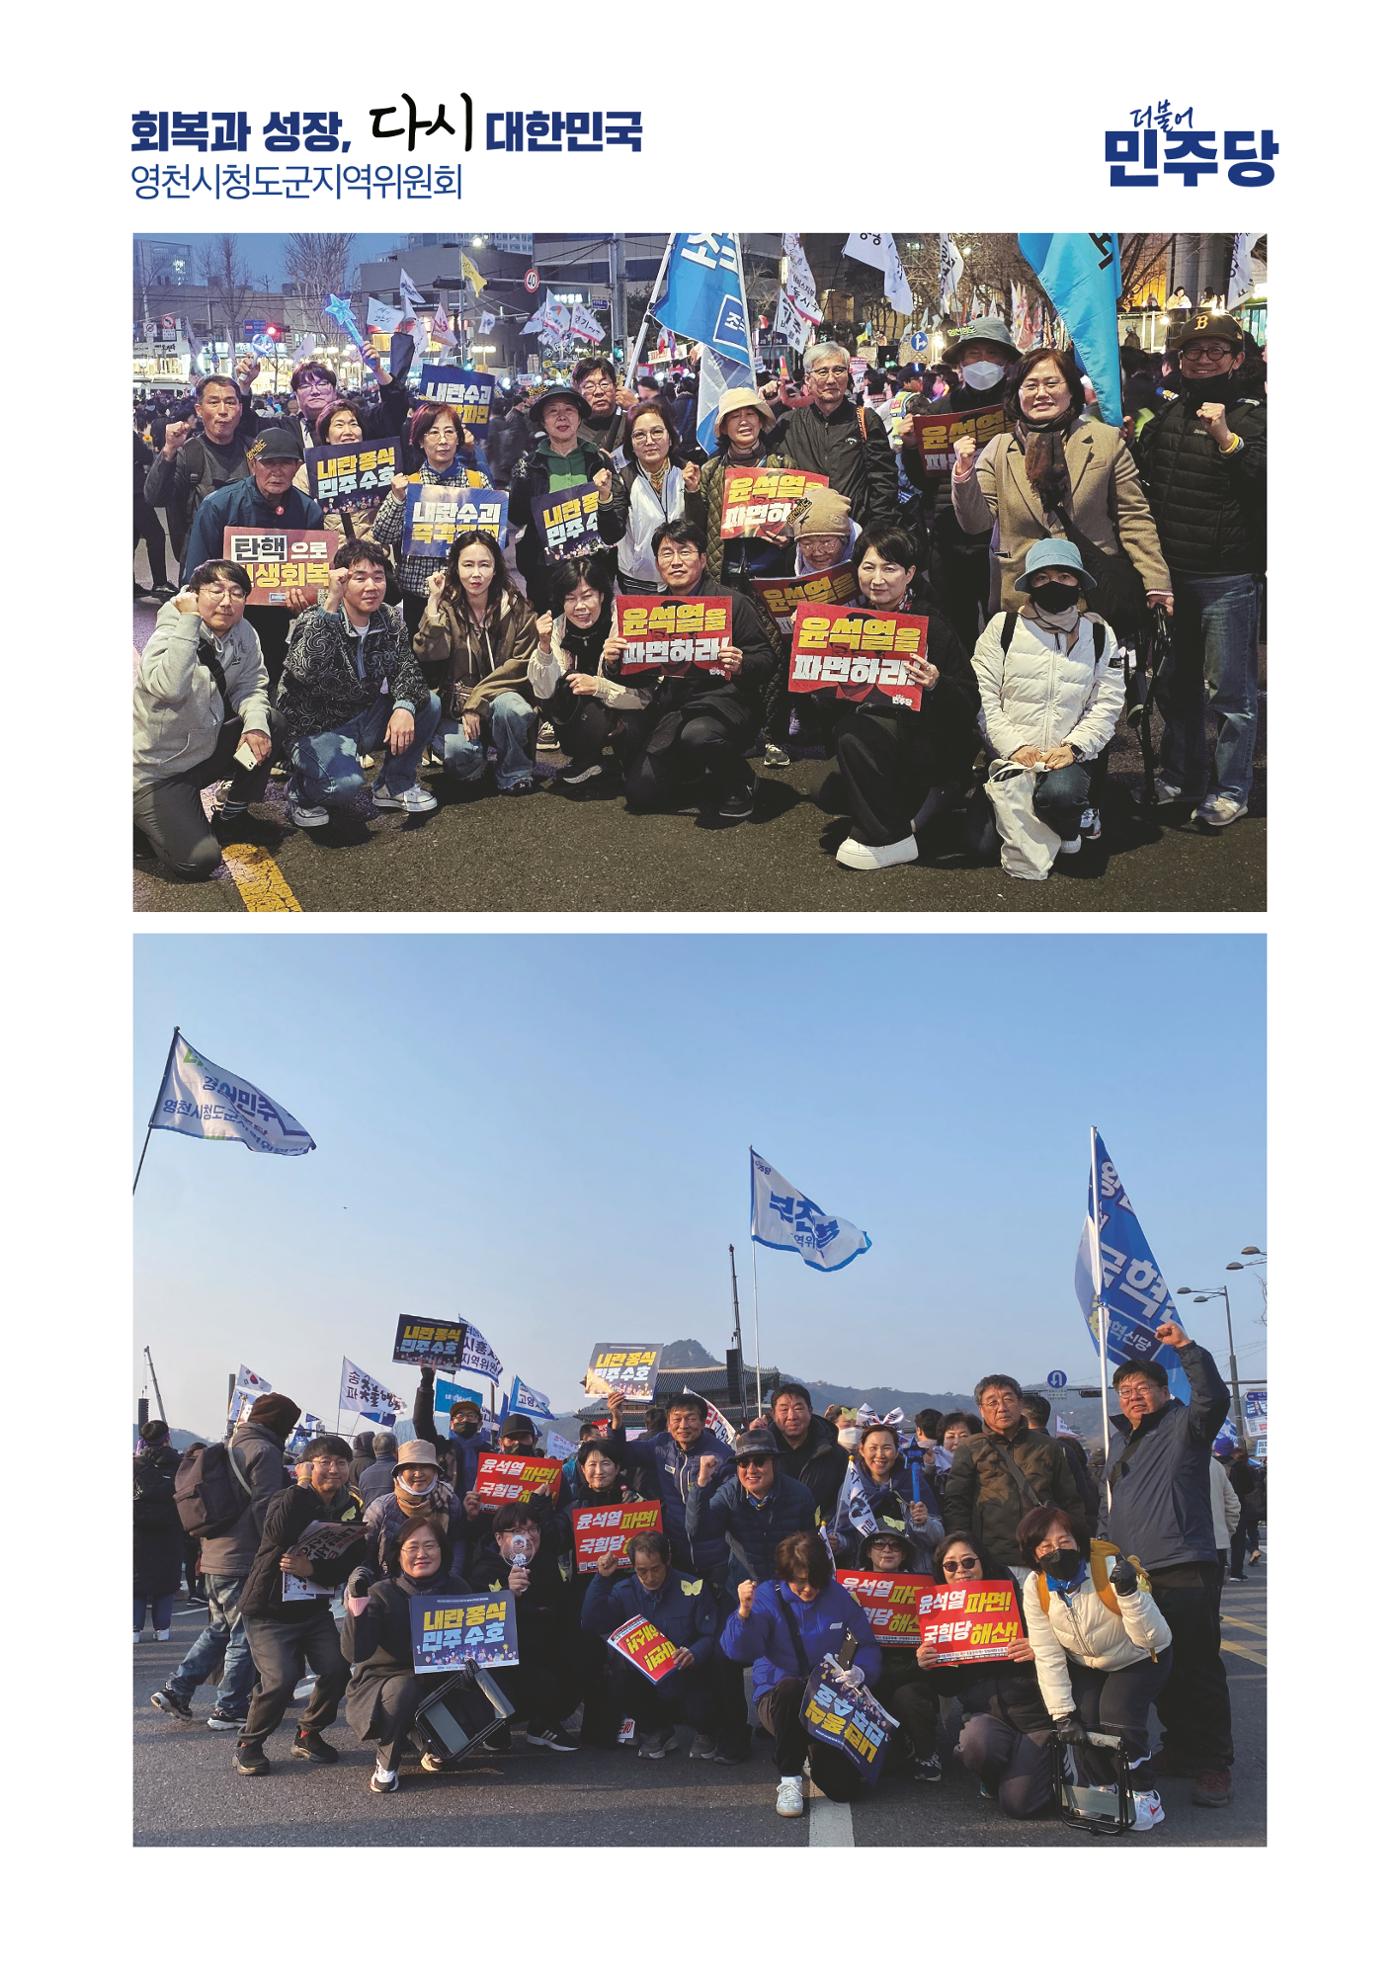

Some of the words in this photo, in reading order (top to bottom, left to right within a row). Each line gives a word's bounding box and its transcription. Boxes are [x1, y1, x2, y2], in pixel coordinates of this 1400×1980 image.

[1194, 316, 1208, 330] B
[317, 455, 359, 481] 내란
[359, 447, 395, 470] 종식
[318, 477, 357, 500] 민주
[360, 467, 397, 490] 수호
[413, 502, 500, 524] 내란수괴
[543, 502, 581, 528] 내란
[582, 491, 600, 510] 종
[546, 520, 585, 548] 민주
[234, 537, 286, 561] 탄핵
[290, 541, 328, 559] 으로
[622, 603, 727, 636] 윤석열을
[797, 616, 922, 653] 윤석열을
[403, 1325, 435, 1340] 내란
[400, 1338, 431, 1353] 민주
[431, 1340, 459, 1355] 수호
[596, 1352, 627, 1367] 내란
[627, 1351, 657, 1366] 종식
[623, 1366, 651, 1382] 수호
[480, 1458, 525, 1476] 윤석열
[519, 1466, 560, 1485] 파면!
[479, 1481, 523, 1500] 국힘당
[576, 1510, 623, 1530] 윤석열
[619, 1509, 659, 1530] 파면!
[579, 1535, 625, 1555] 국힘당
[424, 1608, 465, 1631] 내란
[465, 1601, 507, 1626] 종식
[918, 1590, 967, 1615] 윤석열
[964, 1592, 1012, 1614] 파면!
[422, 1629, 462, 1652] 민주
[464, 1622, 505, 1645] 수호
[923, 1620, 973, 1645] 국힘당
[971, 1622, 1018, 1645] 해산!
[813, 1683, 854, 1717] 수호
[805, 1699, 847, 1735] 종식
[851, 1710, 886, 1747] 민주
[844, 1722, 878, 1763] 내란
